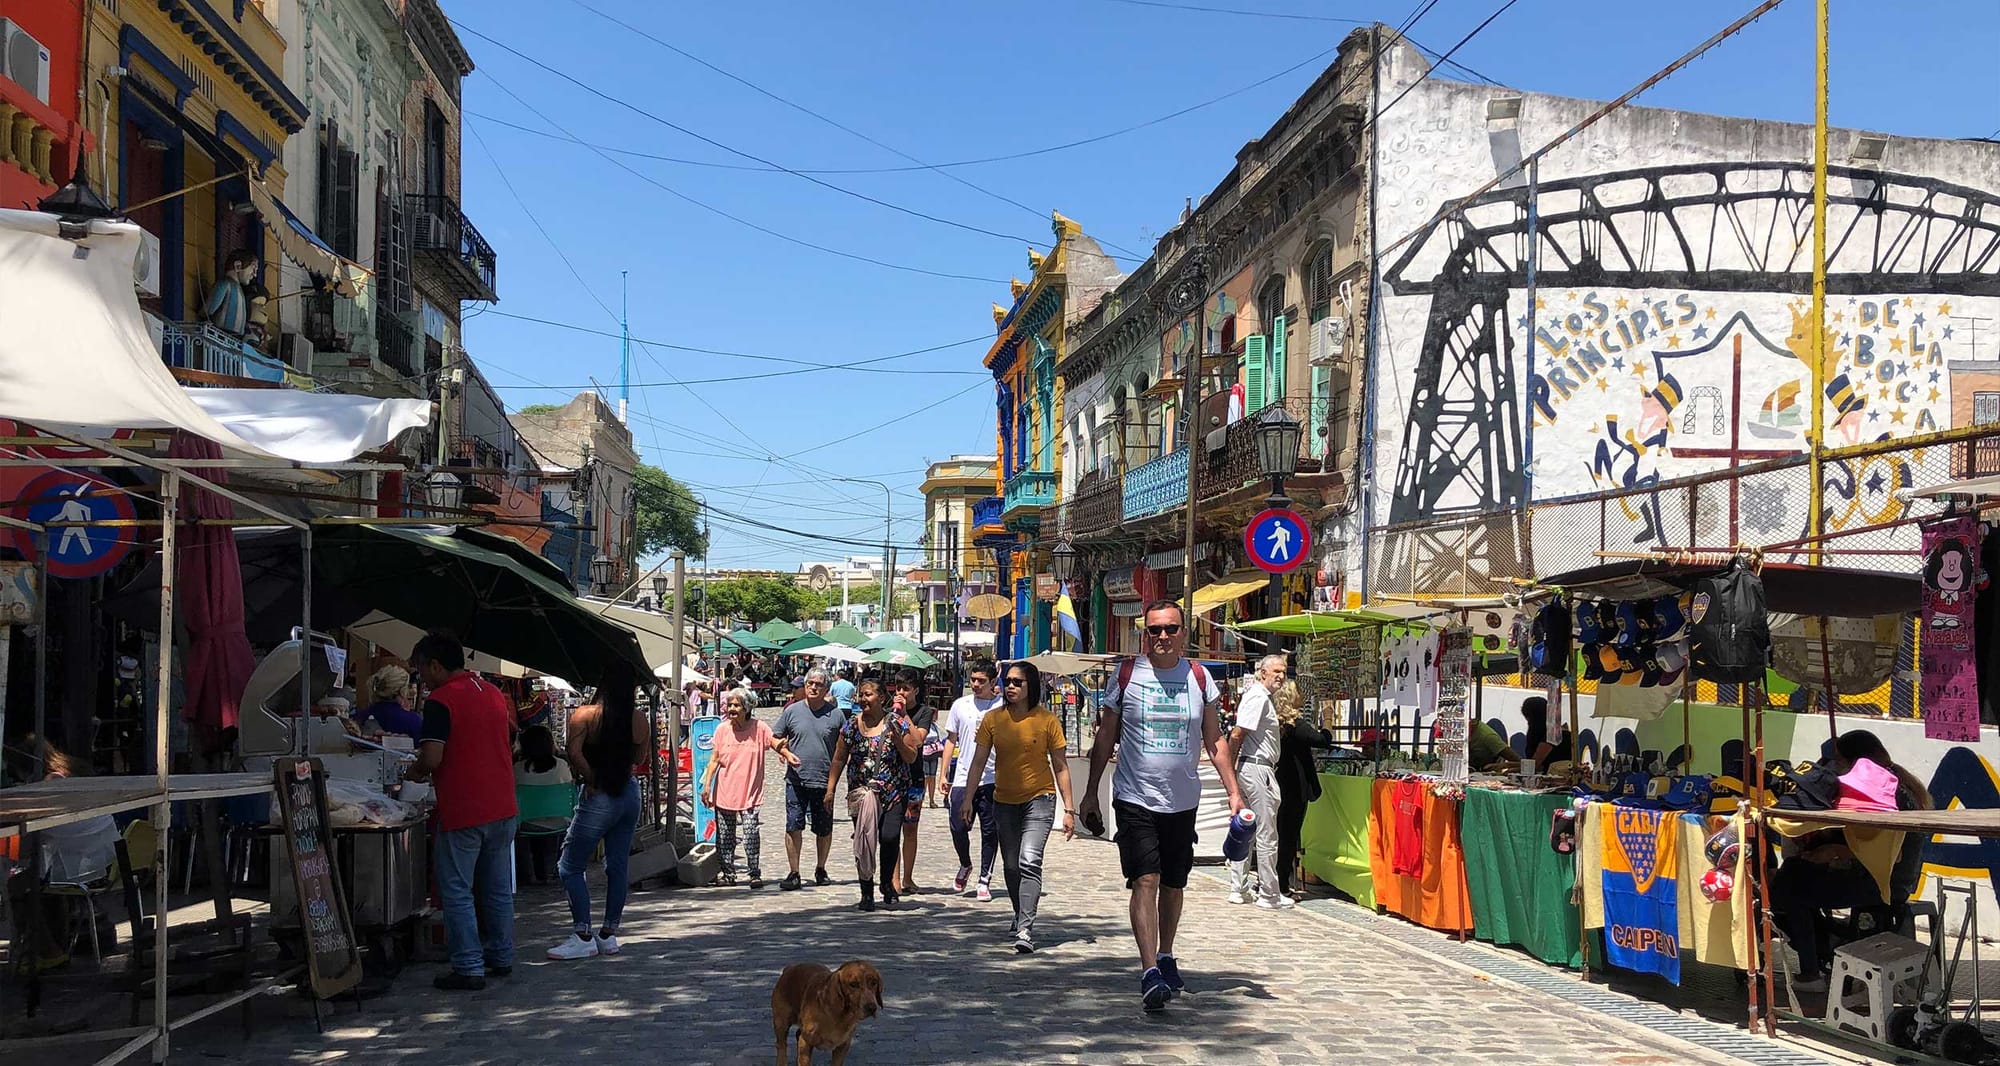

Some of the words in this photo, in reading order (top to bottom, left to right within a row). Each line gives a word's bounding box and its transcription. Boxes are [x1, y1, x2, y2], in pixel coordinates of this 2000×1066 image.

[1536, 291, 1609, 358] LOS
[1859, 299, 1900, 328] DE
[1533, 293, 1697, 426] PRINCIPES
[1909, 325, 1943, 366] LA
[1854, 334, 1937, 431] BOCA
[1646, 659, 1657, 672] B
[1682, 781, 1695, 793] B
